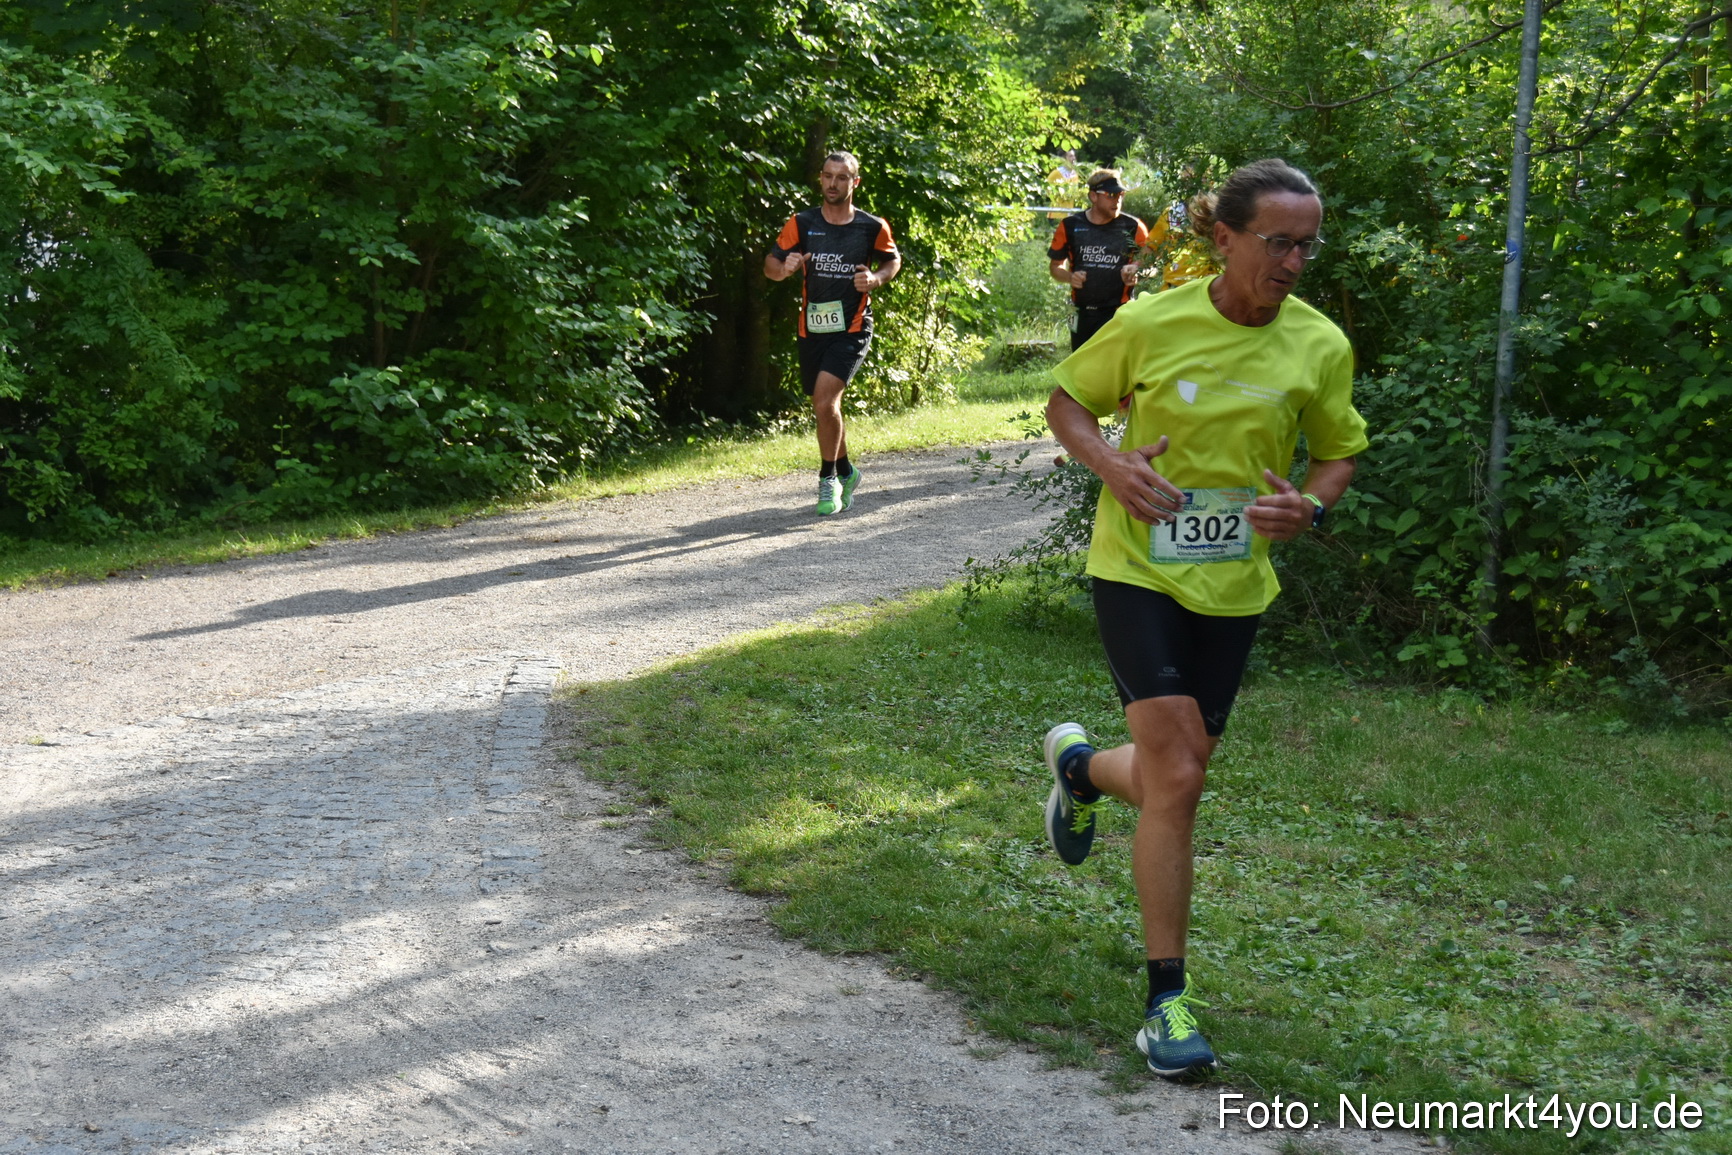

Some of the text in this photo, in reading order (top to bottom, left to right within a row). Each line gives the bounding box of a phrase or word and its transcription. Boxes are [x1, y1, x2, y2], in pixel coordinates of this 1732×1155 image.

[1079, 245, 1107, 255] HECK
[811, 252, 844, 263] HECK
[1082, 254, 1120, 264] DESIGN
[815, 262, 857, 273] DESIGN
[810, 312, 839, 325] 1016
[1164, 514, 1240, 542] 1302
